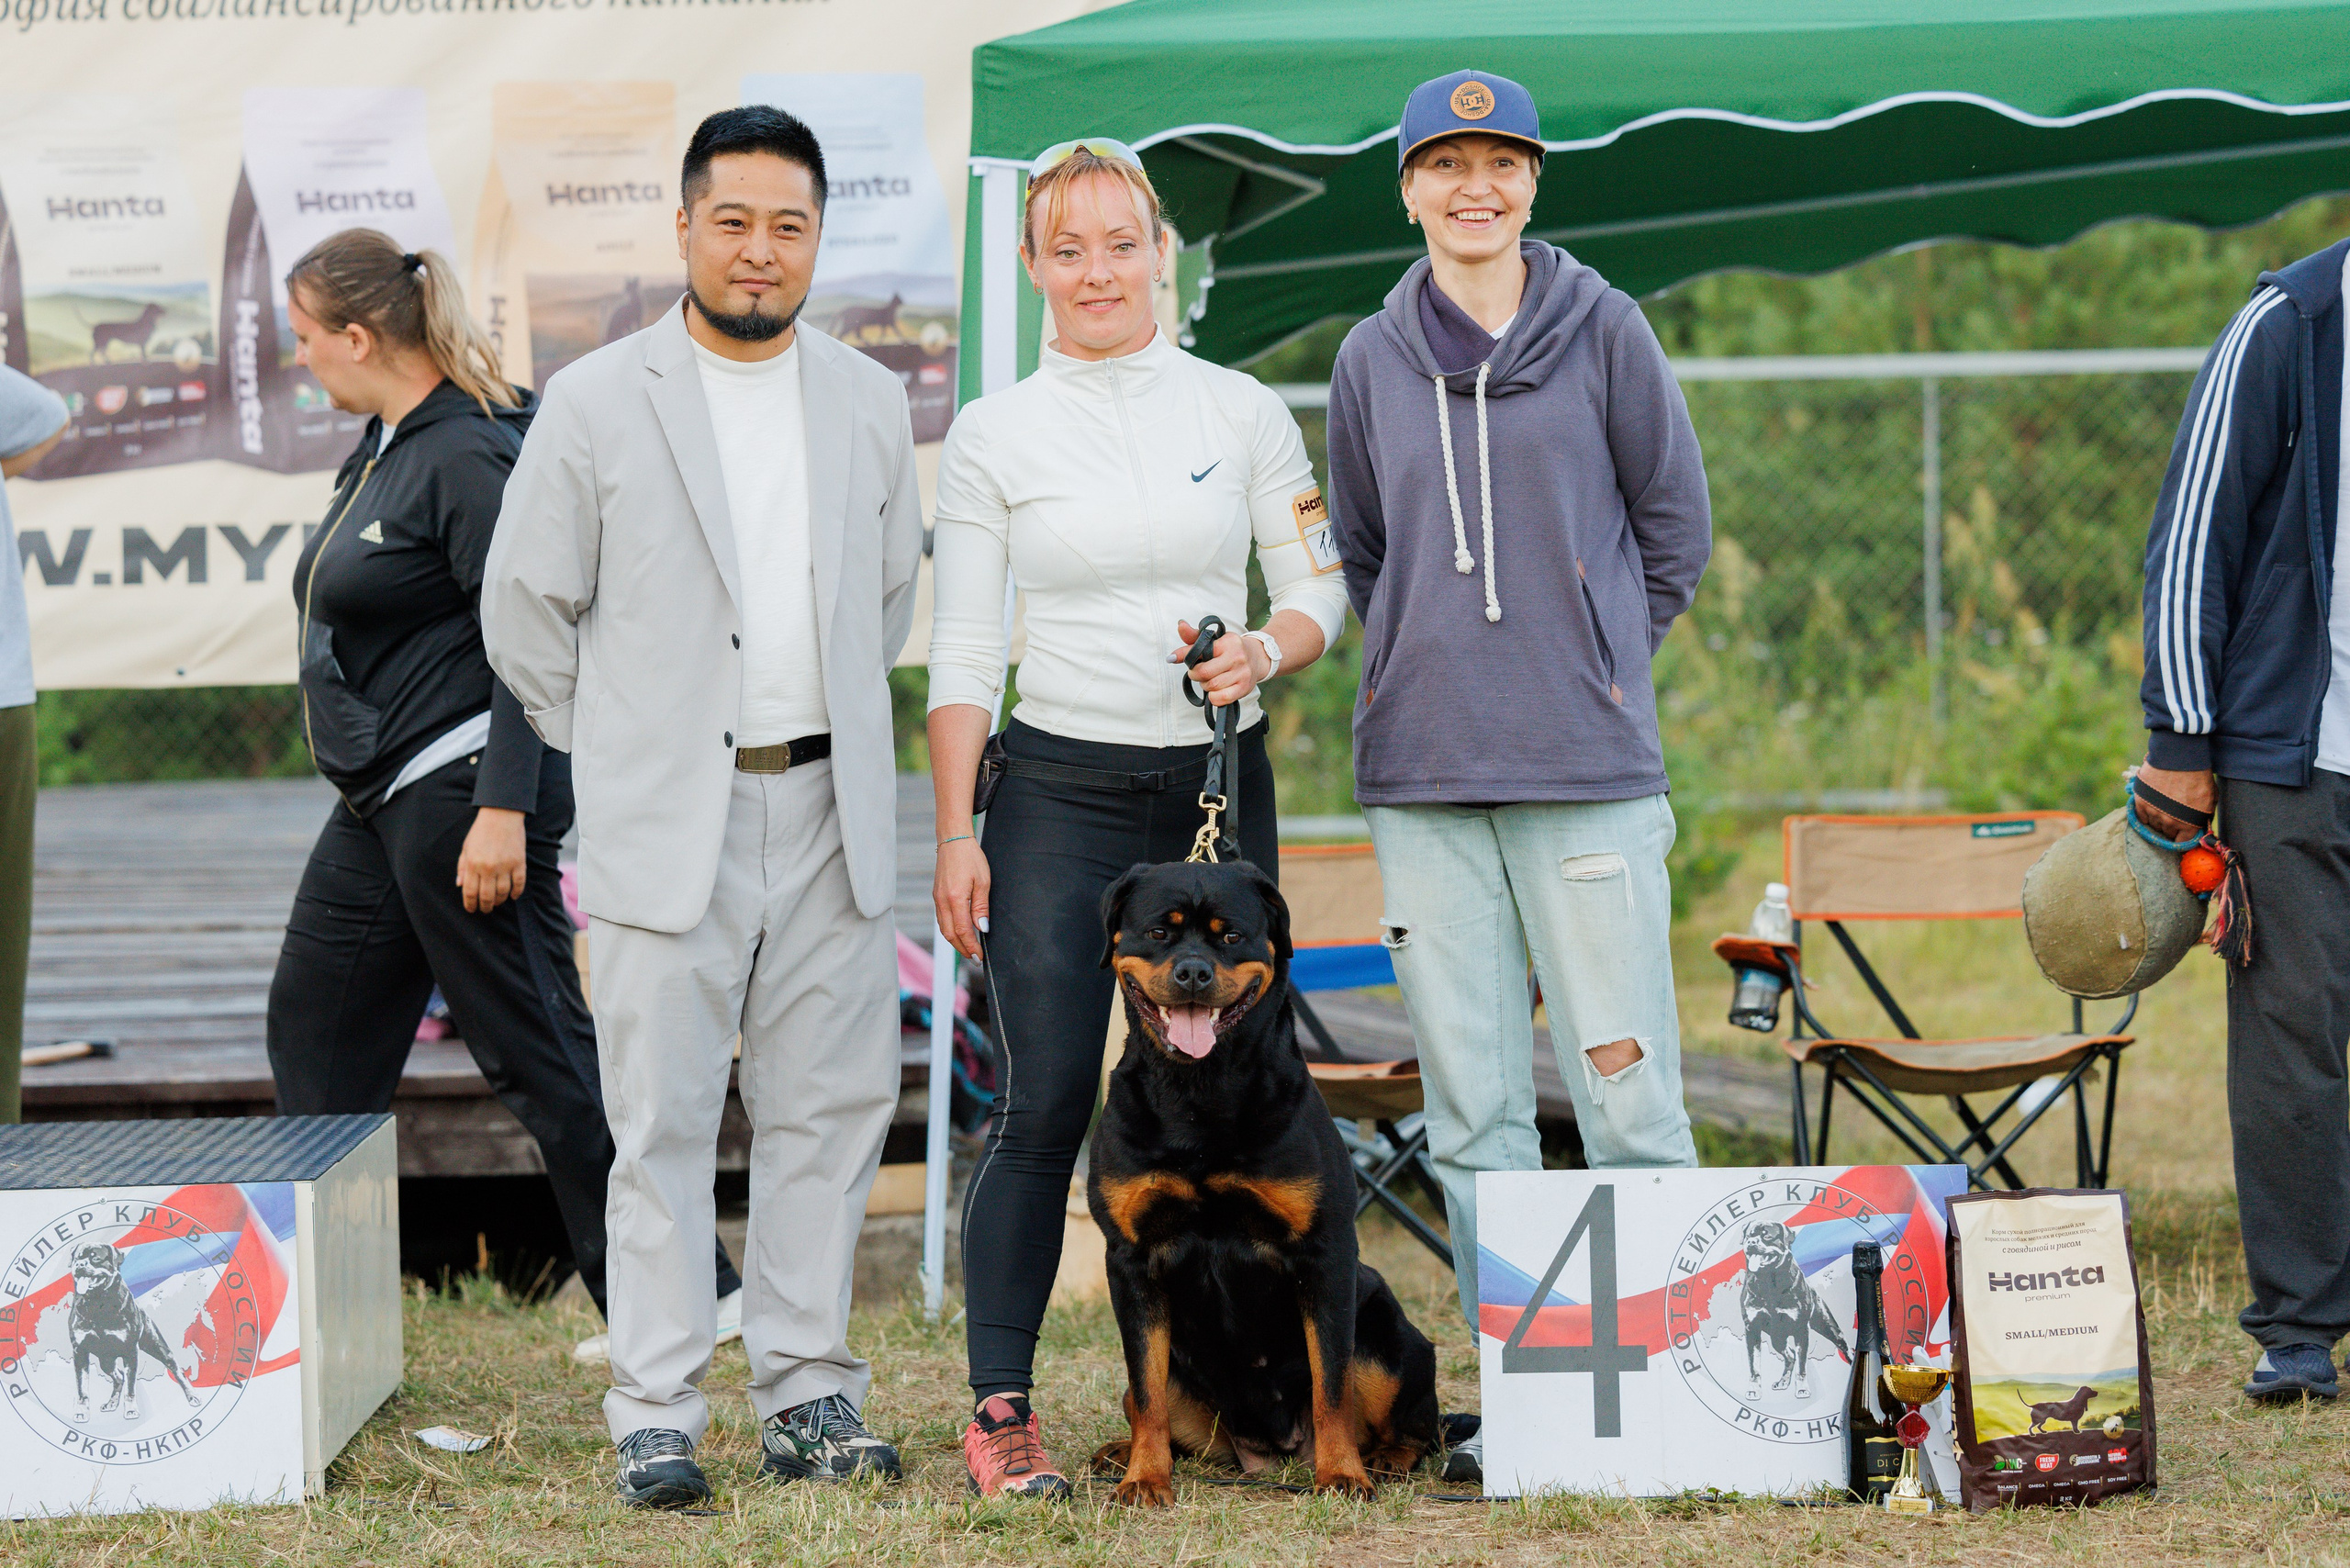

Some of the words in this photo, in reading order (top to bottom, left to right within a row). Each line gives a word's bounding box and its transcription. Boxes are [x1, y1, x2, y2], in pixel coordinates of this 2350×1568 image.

[123, 0, 592, 25] сбалансиро
[545, 181, 663, 207] Hanta
[827, 174, 911, 198] anta
[46, 196, 165, 220] Hanta
[296, 189, 416, 214] Hanta
[236, 300, 264, 454] Hanta
[1298, 494, 1324, 515] Han
[2008, 1227, 2023, 1236] сухой
[2028, 1234, 2050, 1242] мелких
[2055, 1230, 2079, 1238] средних
[2007, 1242, 2049, 1254] говядиной
[2049, 1243, 2055, 1251] и
[2056, 1239, 2082, 1250] рисом
[1671, 1190, 1764, 1374] РОТВЕЙЛЕР
[1786, 1184, 1874, 1224] КЛУБ
[1988, 1265, 2105, 1292] Hanta
[115, 1205, 205, 1243] КЛУБ
[211, 1249, 255, 1390] РОССИИ
[2024, 1292, 2071, 1303] premium
[1502, 1184, 1648, 1438] 4
[2005, 1325, 2098, 1340] SMALL/MEDIUM
[1734, 1406, 1841, 1439] РКФ-НК
[62, 1417, 203, 1460] РКФ-НКПР
[1877, 1459, 1888, 1467] DI
